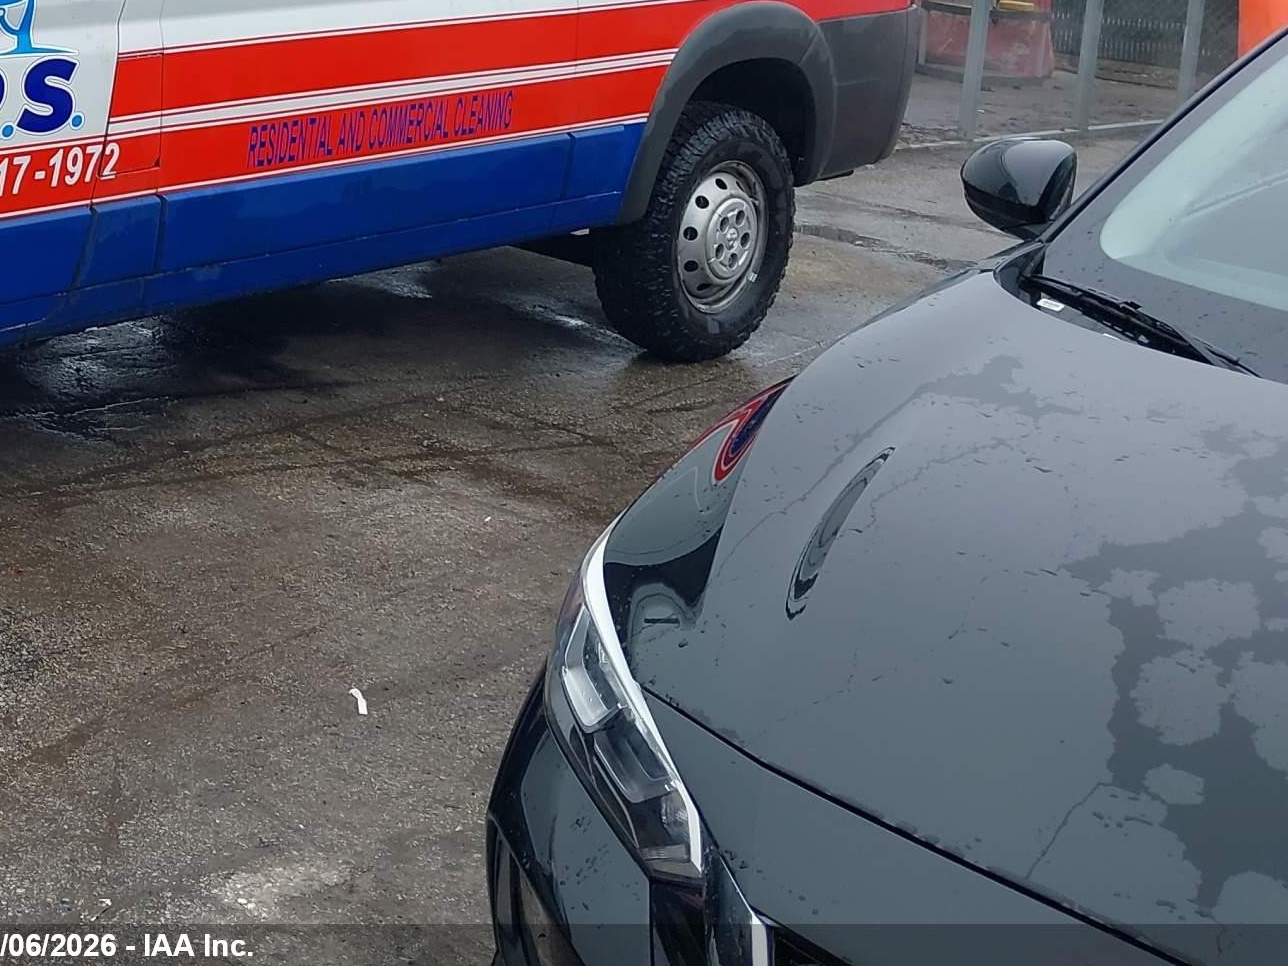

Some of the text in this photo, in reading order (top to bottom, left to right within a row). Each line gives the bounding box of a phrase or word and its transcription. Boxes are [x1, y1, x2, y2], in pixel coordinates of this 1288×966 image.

[247, 90, 514, 169] RESIDENTIAL AND COMMERCIAL CLEANING
